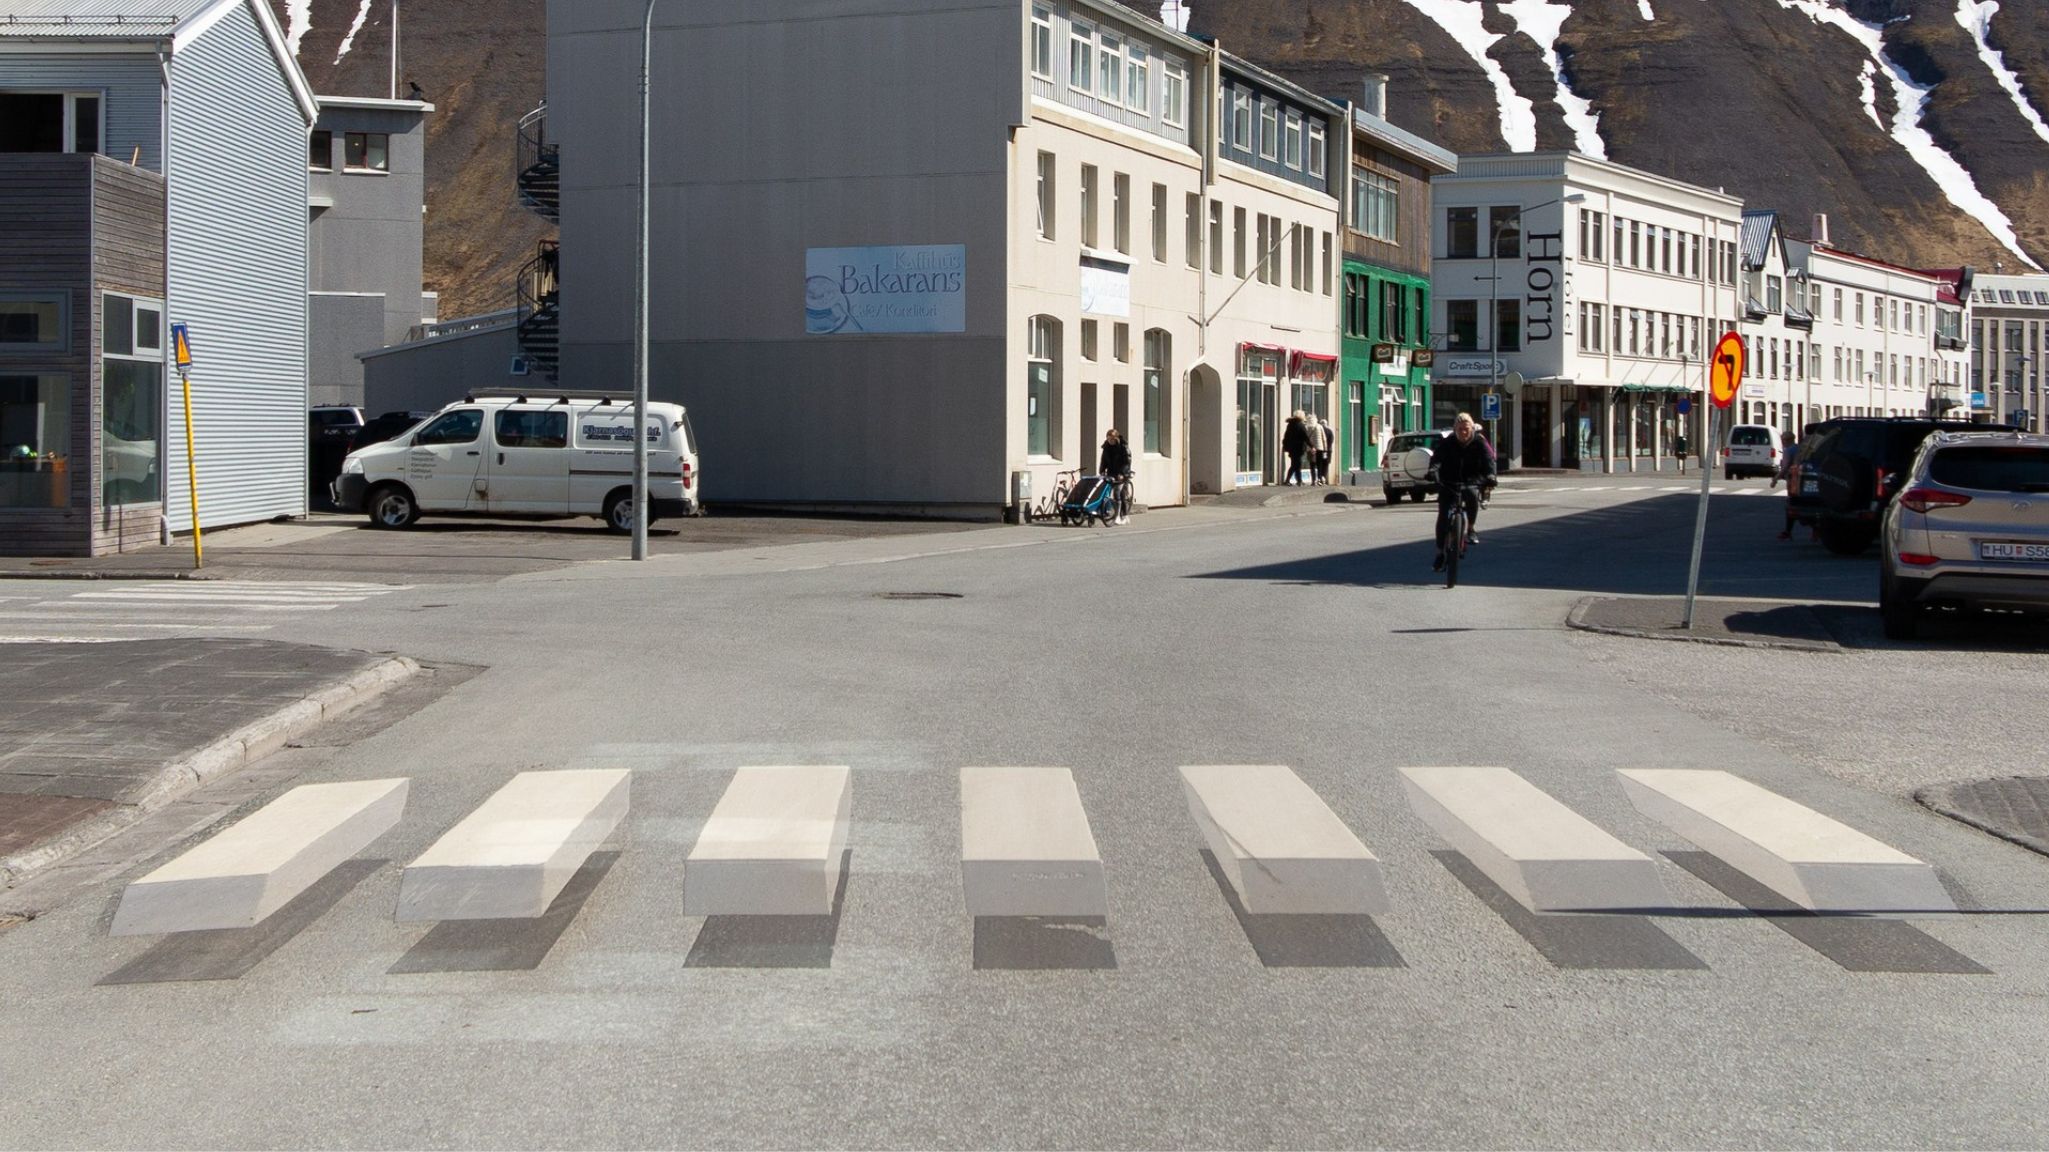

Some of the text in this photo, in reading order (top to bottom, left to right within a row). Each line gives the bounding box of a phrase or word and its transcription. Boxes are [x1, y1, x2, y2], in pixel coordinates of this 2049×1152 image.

[839, 264, 961, 295] Bakarans
[1527, 229, 1562, 345] Horn
[1487, 395, 1497, 409] P
[1993, 545, 2013, 556] HU
